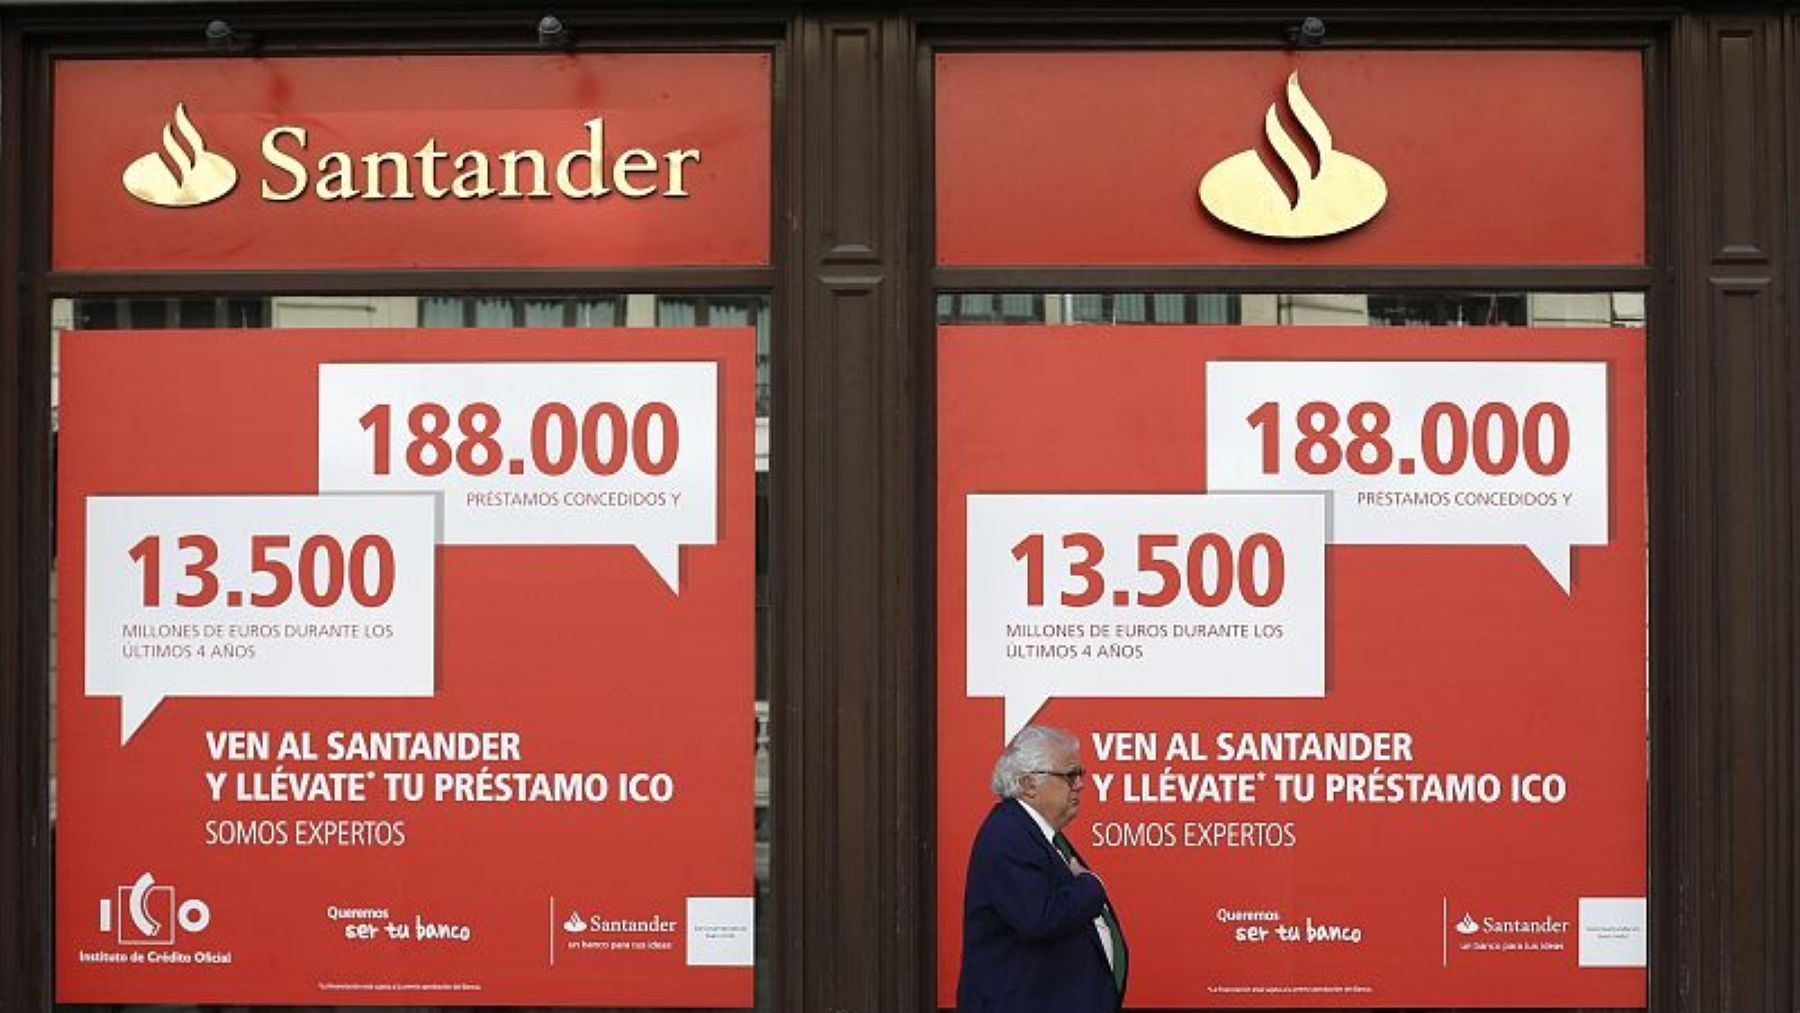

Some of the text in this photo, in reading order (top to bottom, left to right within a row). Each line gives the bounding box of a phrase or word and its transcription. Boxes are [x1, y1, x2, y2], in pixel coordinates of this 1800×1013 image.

[261, 118, 700, 201] Santander
[359, 402, 679, 477] 188.000
[1246, 401, 1570, 476] 188.000
[467, 491, 681, 506] PRÉSTAMOS CONCEDIDOS Y
[1358, 492, 1572, 506] PRÉSTAMOS CONCEDIDOS Y
[128, 534, 395, 607] 13.500
[1011, 533, 1284, 607] 13.500
[123, 625, 393, 638] MILLONES DE EUROS DURANTE LOS
[1007, 624, 1282, 638] MILLONES DE EUROS DURANTE LOS
[123, 642, 254, 658] ÚLTIMOS 4 AÑOS
[1007, 642, 1143, 658] ÚLTIMOS 4 AÑOS
[206, 731, 520, 760] VEN AL SANTANDER
[1092, 733, 1412, 760] VEN AL SANTANDER
[206, 773, 227, 800] Y
[384, 773, 423, 801] TU
[435, 767, 607, 801] PRÉSTAMO
[620, 774, 673, 801] ICO
[1093, 774, 1113, 801] Y
[1275, 774, 1314, 802] TU
[1327, 767, 1500, 801] PRÉSTAMO
[1512, 774, 1565, 802] ICO
[206, 821, 405, 846] SOMOS EXPERTOS
[1093, 823, 1295, 846] SOMOS EXPERTOS
[327, 906, 390, 920] Queremos
[591, 916, 677, 931] Santander
[1217, 908, 1280, 922] Queremos
[1484, 916, 1570, 932] Santander
[345, 914, 471, 941] ser tu banco
[1235, 917, 1362, 943] ser tu banco
[80, 951, 231, 963] Instituto de Crédito Oficial
